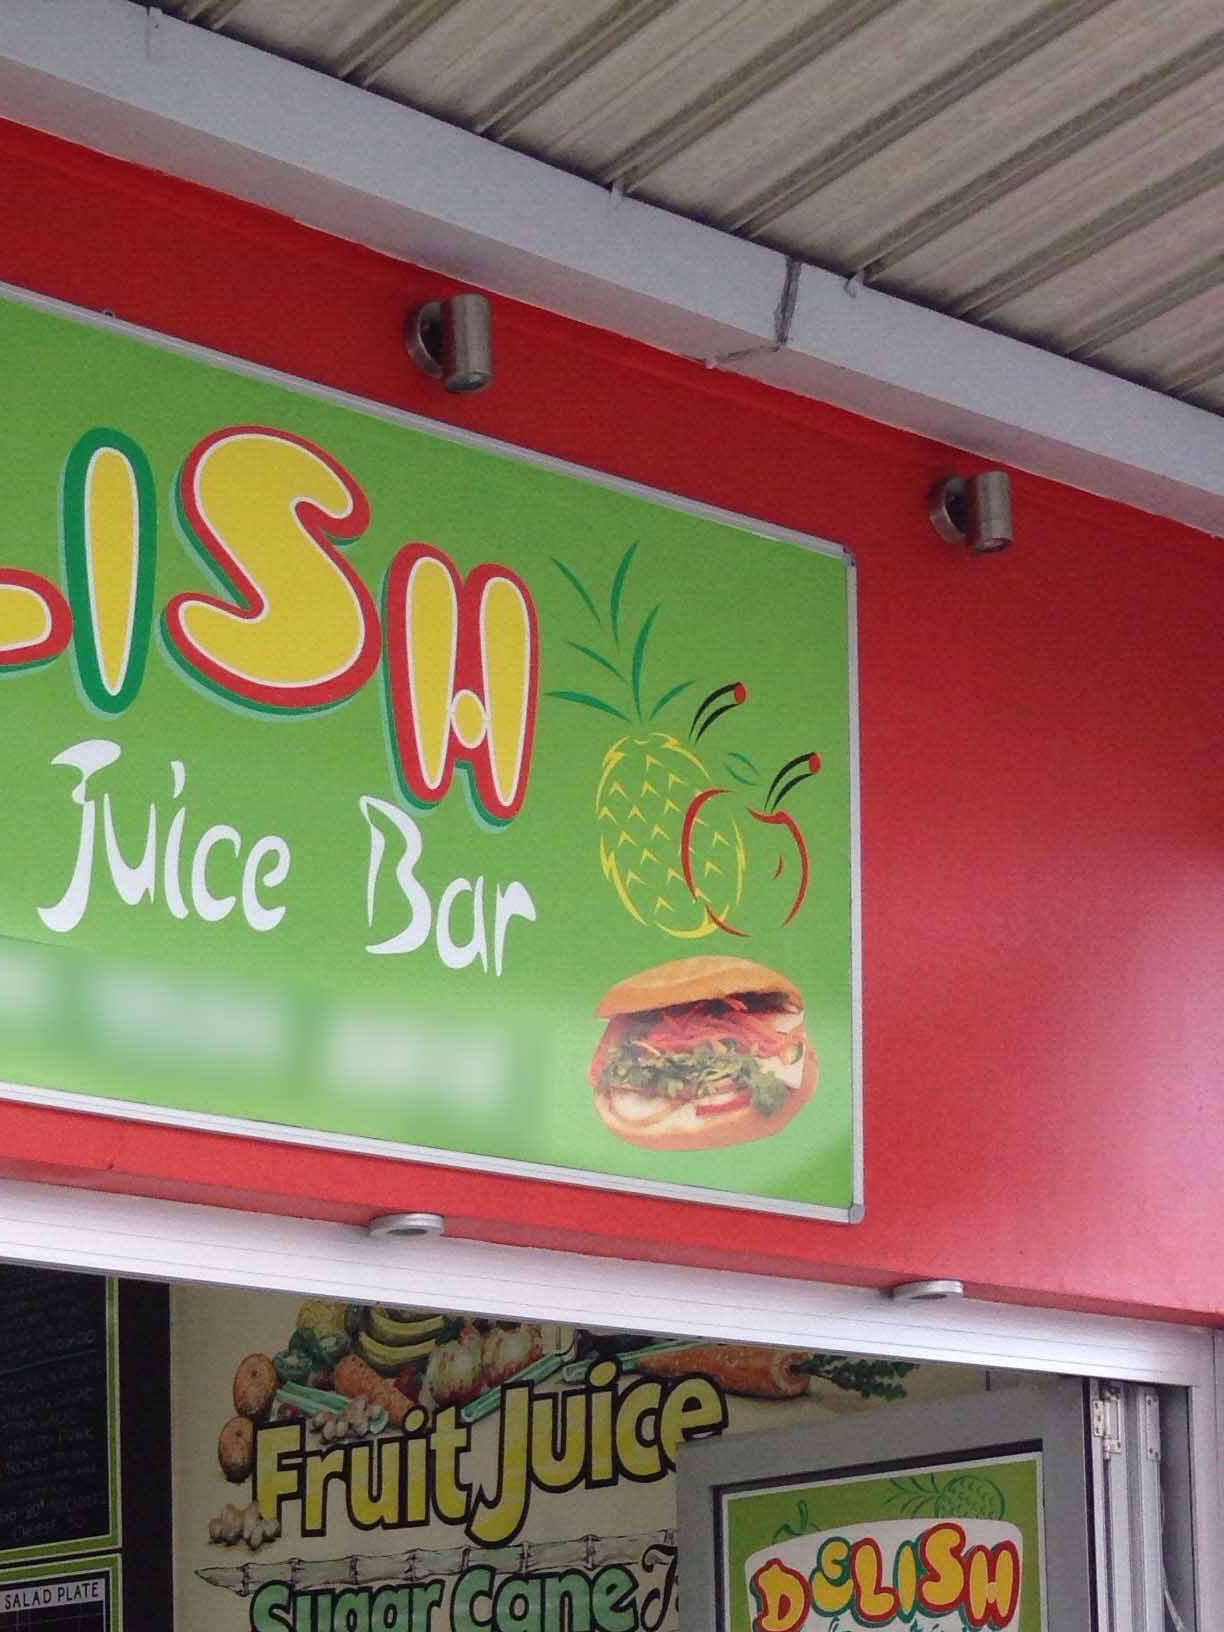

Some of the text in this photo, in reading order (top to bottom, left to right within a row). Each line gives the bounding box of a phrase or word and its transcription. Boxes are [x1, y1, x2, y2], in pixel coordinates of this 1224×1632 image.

[38, 739, 291, 932] Juice
[359, 796, 537, 976] Bar
[252, 1406, 474, 1538] Fruit
[465, 1357, 730, 1549] Juice
[4, 1581, 99, 1610] SALAD PLATE
